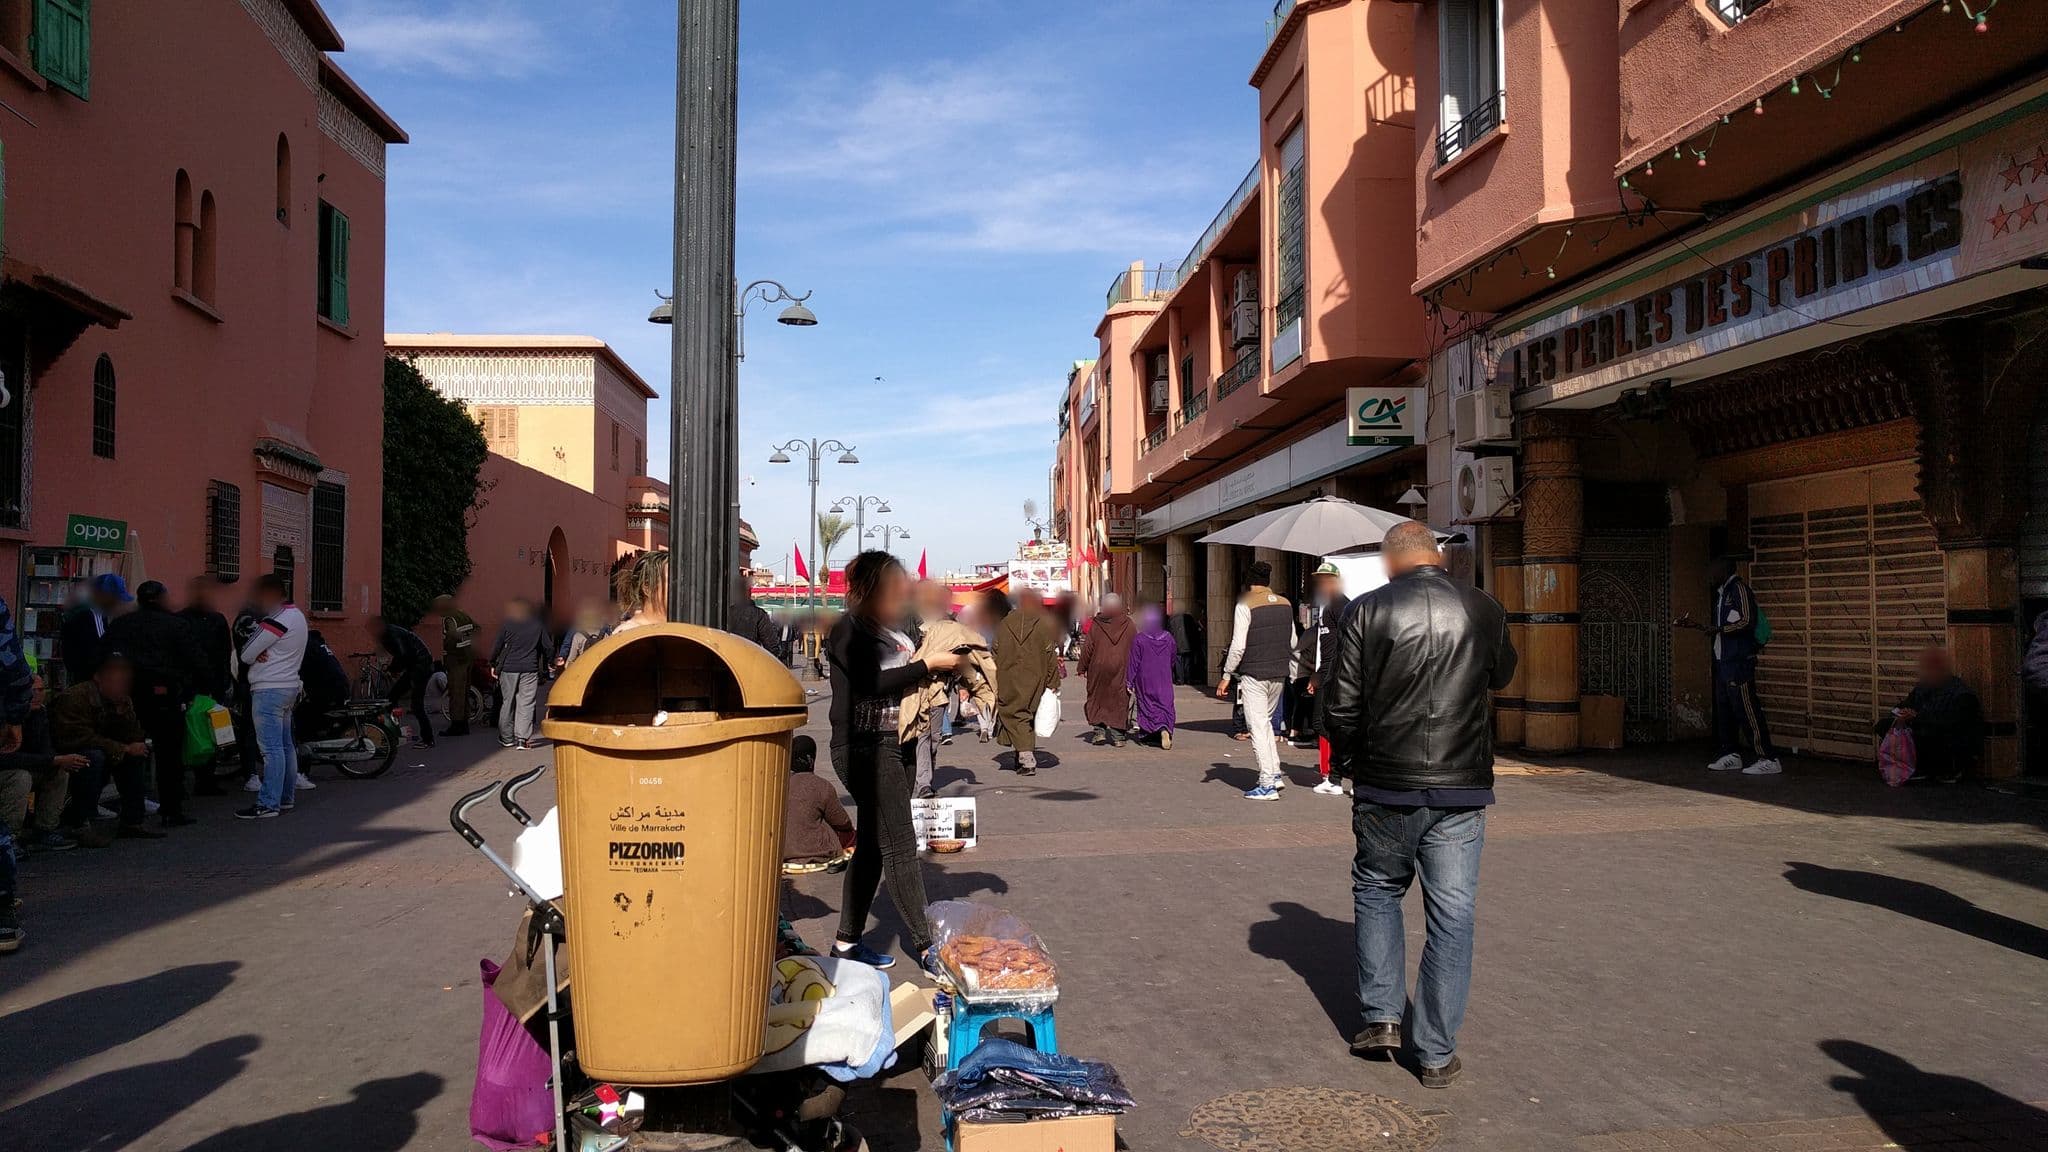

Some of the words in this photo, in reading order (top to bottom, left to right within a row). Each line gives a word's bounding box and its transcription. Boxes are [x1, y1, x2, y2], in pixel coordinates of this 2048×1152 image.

[1513, 336, 1557, 393] LES
[1564, 291, 1673, 374] PERLES
[1685, 261, 1752, 334] DES
[1767, 180, 1962, 308] PRINCES
[73, 523, 120, 542] oppo
[609, 806, 651, 821] مراكش
[655, 805, 685, 821] مدينة
[610, 824, 627, 832] Ville
[629, 824, 639, 832] de
[641, 824, 686, 832] Marrakech
[609, 841, 685, 860] PIZZORNO
